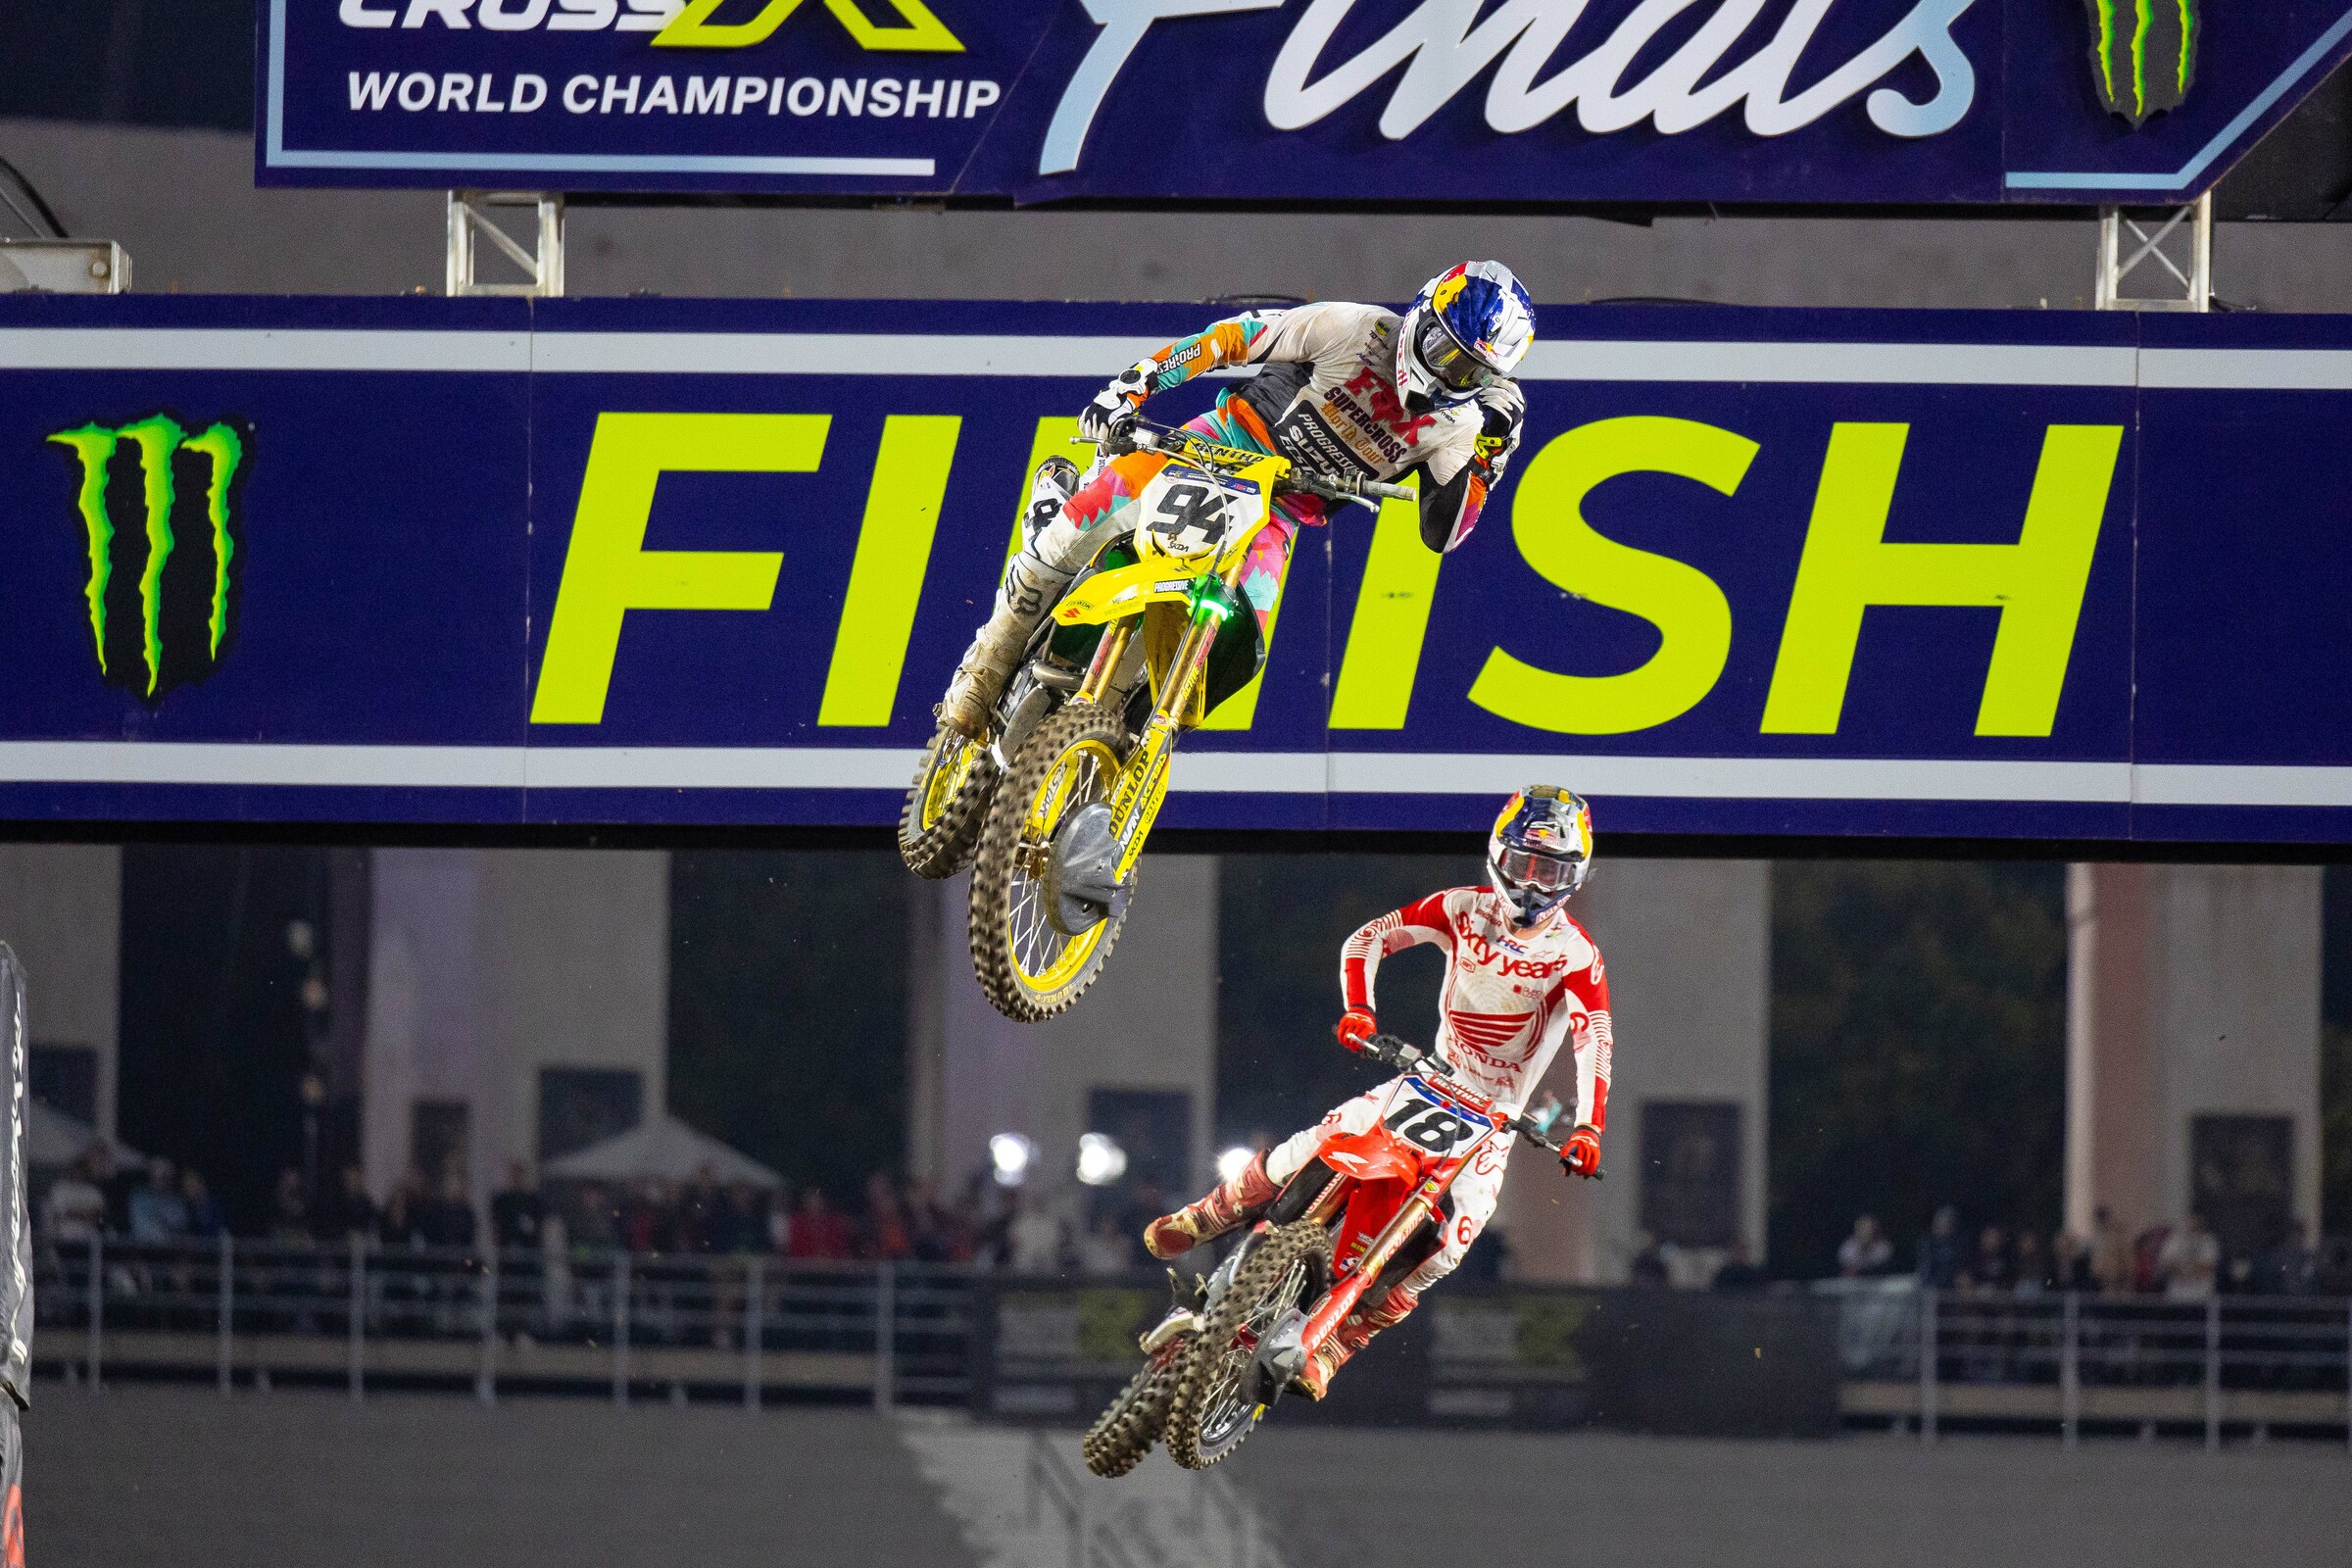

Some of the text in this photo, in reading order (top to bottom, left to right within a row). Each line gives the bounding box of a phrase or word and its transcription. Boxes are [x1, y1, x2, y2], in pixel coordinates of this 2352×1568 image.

[348, 72, 1001, 119] WORLD CHAMPIONSHIP
[1157, 343, 1200, 374] PRORES
[1192, 441, 1265, 463] RENTHA
[1289, 424, 1340, 475] SUZU
[1298, 414, 1364, 475] PROGRESSI
[1321, 400, 1386, 466] World Tour
[1324, 386, 1407, 464] SUPERCROSS
[1279, 434, 1317, 476] ECST
[1146, 483, 1240, 545] 94
[1108, 750, 1150, 835] DUNLOP
[1447, 1035, 1522, 1073] HONDA
[1383, 1098, 1474, 1152] 18
[1310, 1290, 1356, 1348] DUNLOP
